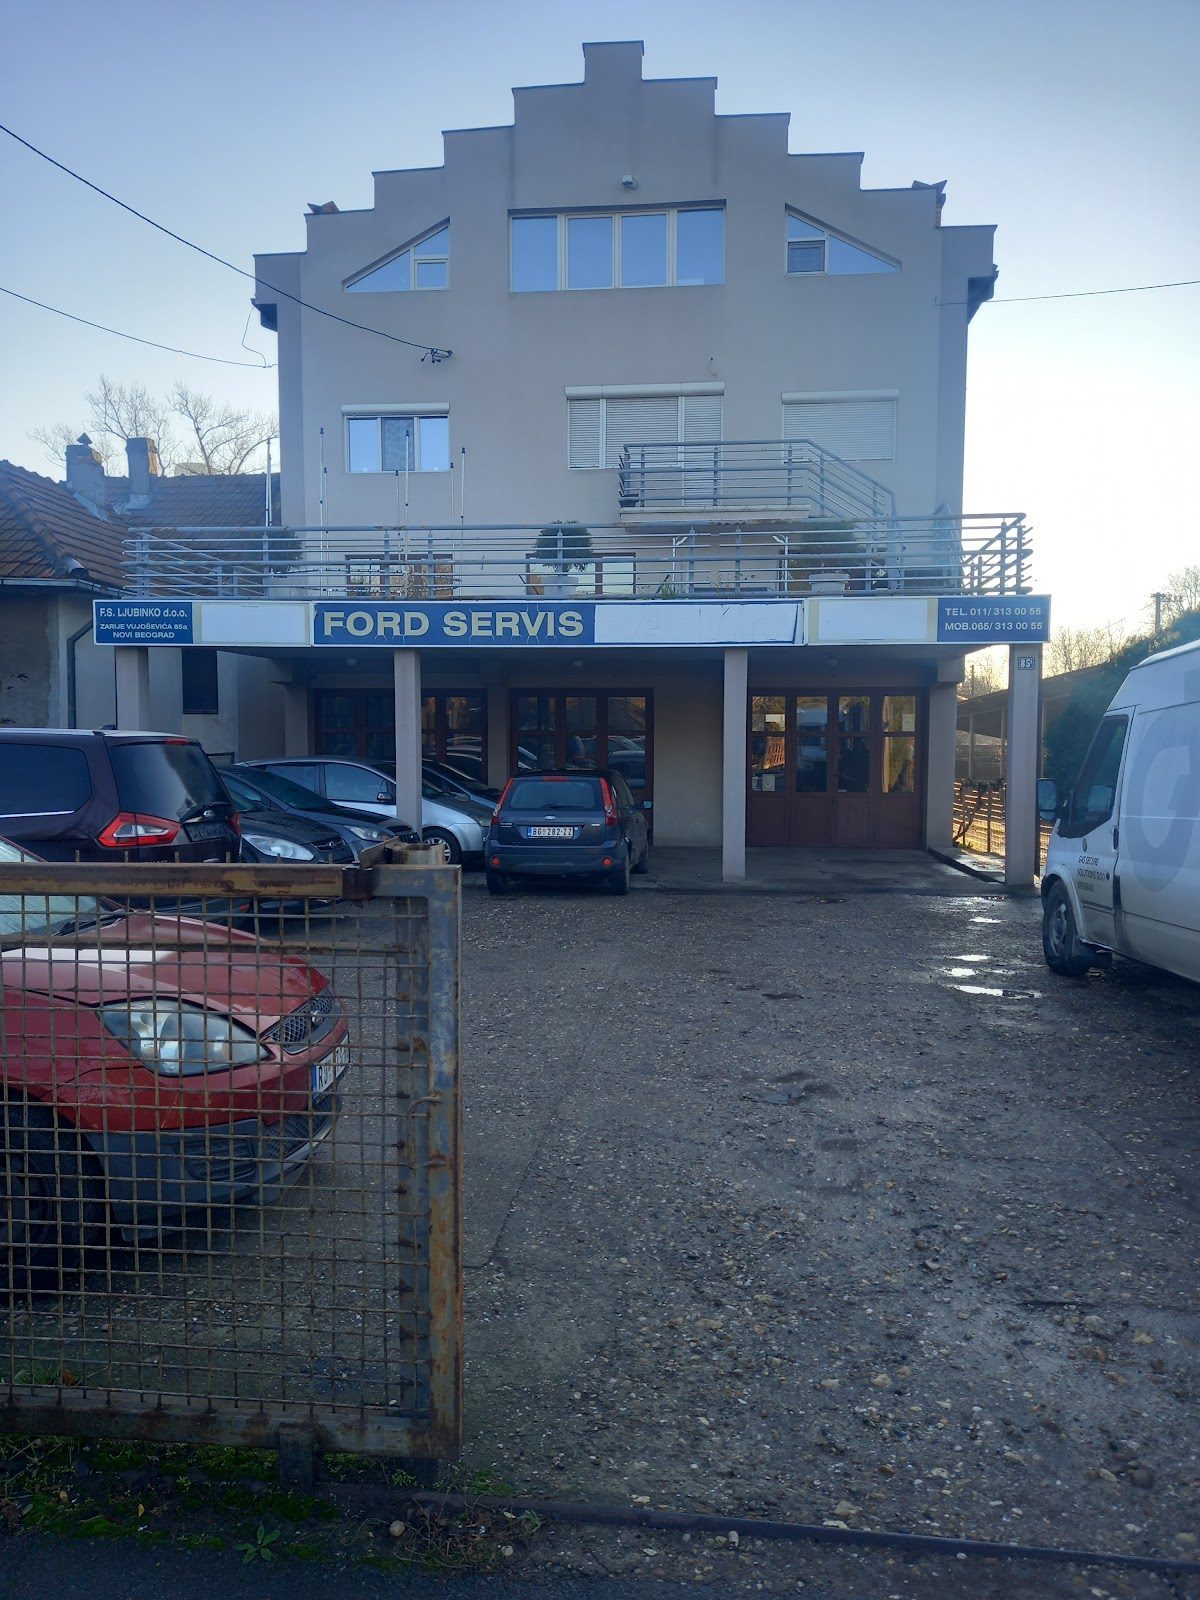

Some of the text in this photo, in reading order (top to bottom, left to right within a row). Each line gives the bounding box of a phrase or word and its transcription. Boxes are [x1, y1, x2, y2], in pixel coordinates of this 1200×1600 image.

[99, 607, 188, 617] F.S. LJUBINKO d.o.o.
[944, 607, 1042, 617] TEL. 011/ 313 00 55
[126, 622, 173, 630] VUJOŠEVIĆA
[323, 611, 584, 637] FORD SERVIS
[994, 622, 1013, 631] 313
[1015, 622, 1028, 631] 00
[1030, 622, 1043, 631] 55
[112, 631, 175, 639] NOVI BEOGRAD
[532, 827, 542, 836] BG
